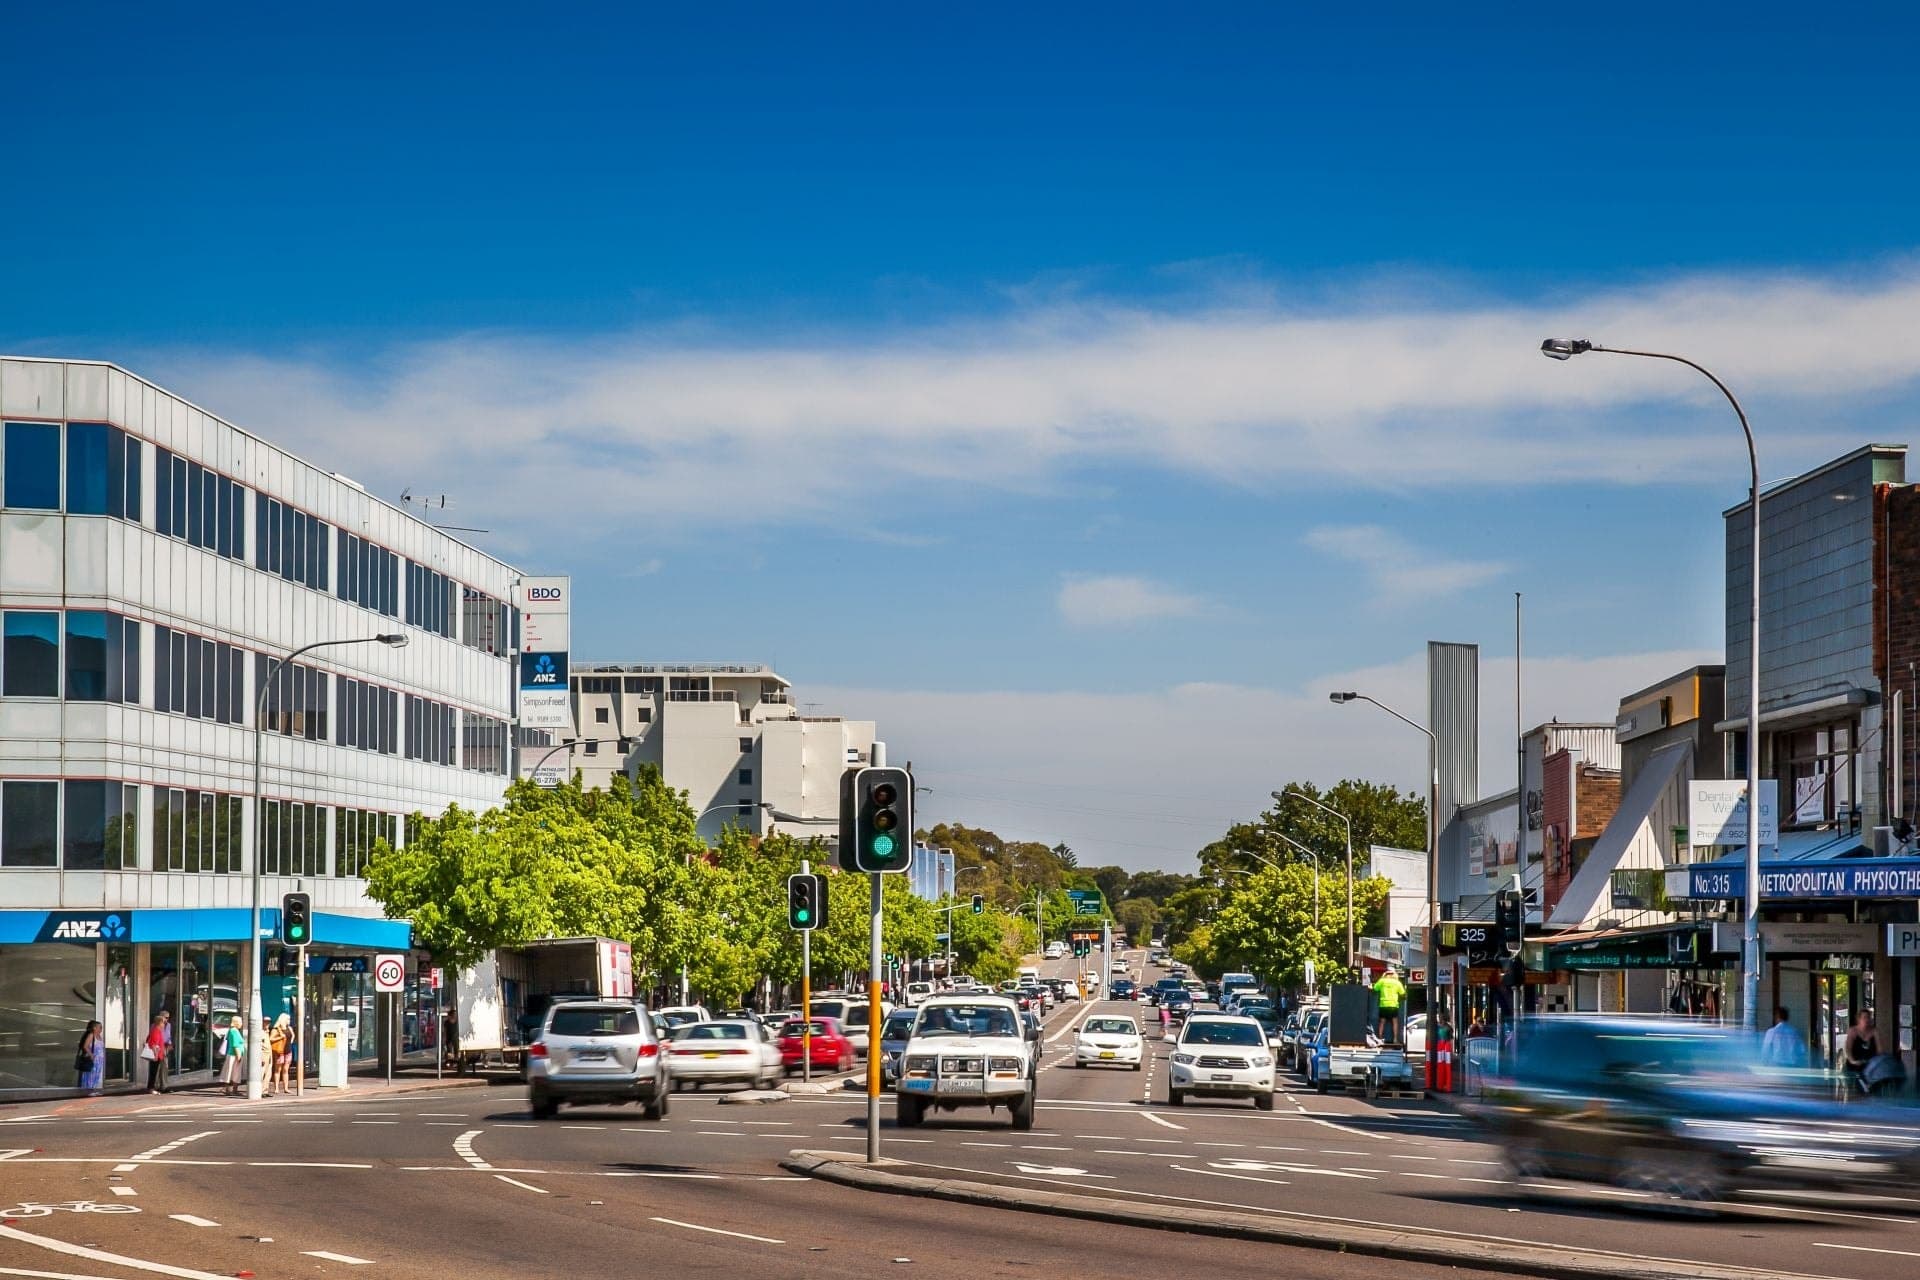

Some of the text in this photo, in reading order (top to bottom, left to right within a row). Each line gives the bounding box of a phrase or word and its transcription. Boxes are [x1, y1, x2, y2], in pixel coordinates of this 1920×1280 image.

[532, 588, 561, 599] BDO
[533, 674, 556, 683] ANZ
[1698, 790, 1734, 802] Dental
[1695, 875, 1711, 893] No:
[1713, 874, 1730, 893] 315
[1758, 872, 1845, 892] METROPOLITAN
[52, 920, 101, 938] ANZ
[1460, 928, 1486, 942] 325
[329, 962, 353, 971] ANZ
[381, 967, 398, 979] 60
